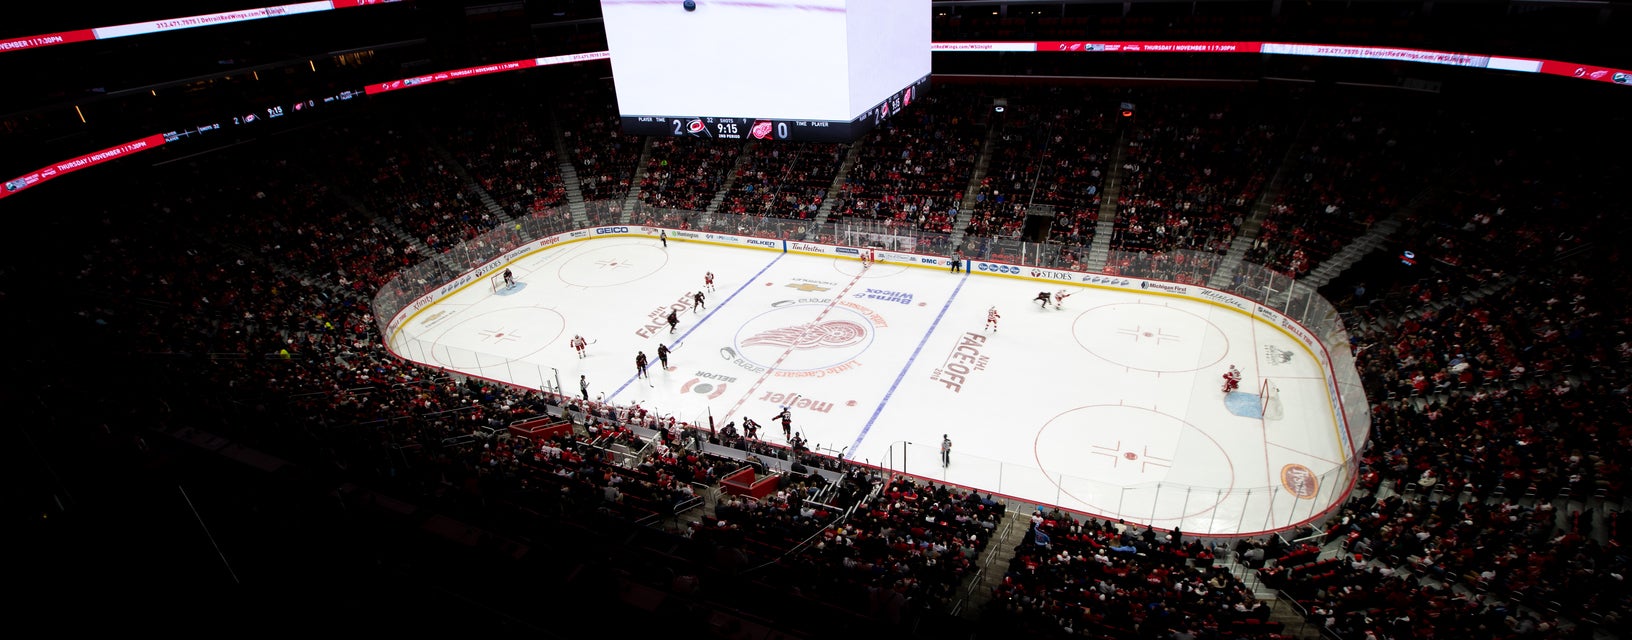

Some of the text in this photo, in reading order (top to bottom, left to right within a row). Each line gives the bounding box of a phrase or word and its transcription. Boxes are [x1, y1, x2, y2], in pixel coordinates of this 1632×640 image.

[0, 40, 28, 51] VEMBER
[673, 120, 682, 135] 2
[717, 123, 738, 134] 9:15
[778, 122, 788, 139] 0
[57, 158, 87, 172] THURSDAY
[91, 148, 121, 162] NOVEMBER
[596, 227, 629, 235] GEICO
[540, 236, 560, 247] meijer
[747, 239, 775, 248] FALKEN
[803, 243, 825, 253] Hortons
[921, 257, 937, 265] DMC
[1149, 282, 1174, 291] Michigan
[865, 287, 914, 300] Wilcox
[867, 294, 913, 305] Burns
[647, 306, 667, 319] NHL
[732, 357, 766, 375] arena
[825, 359, 863, 375] Little
[973, 355, 990, 371] NHL
[695, 369, 738, 384] BELFOR
[758, 390, 835, 414] meijer
